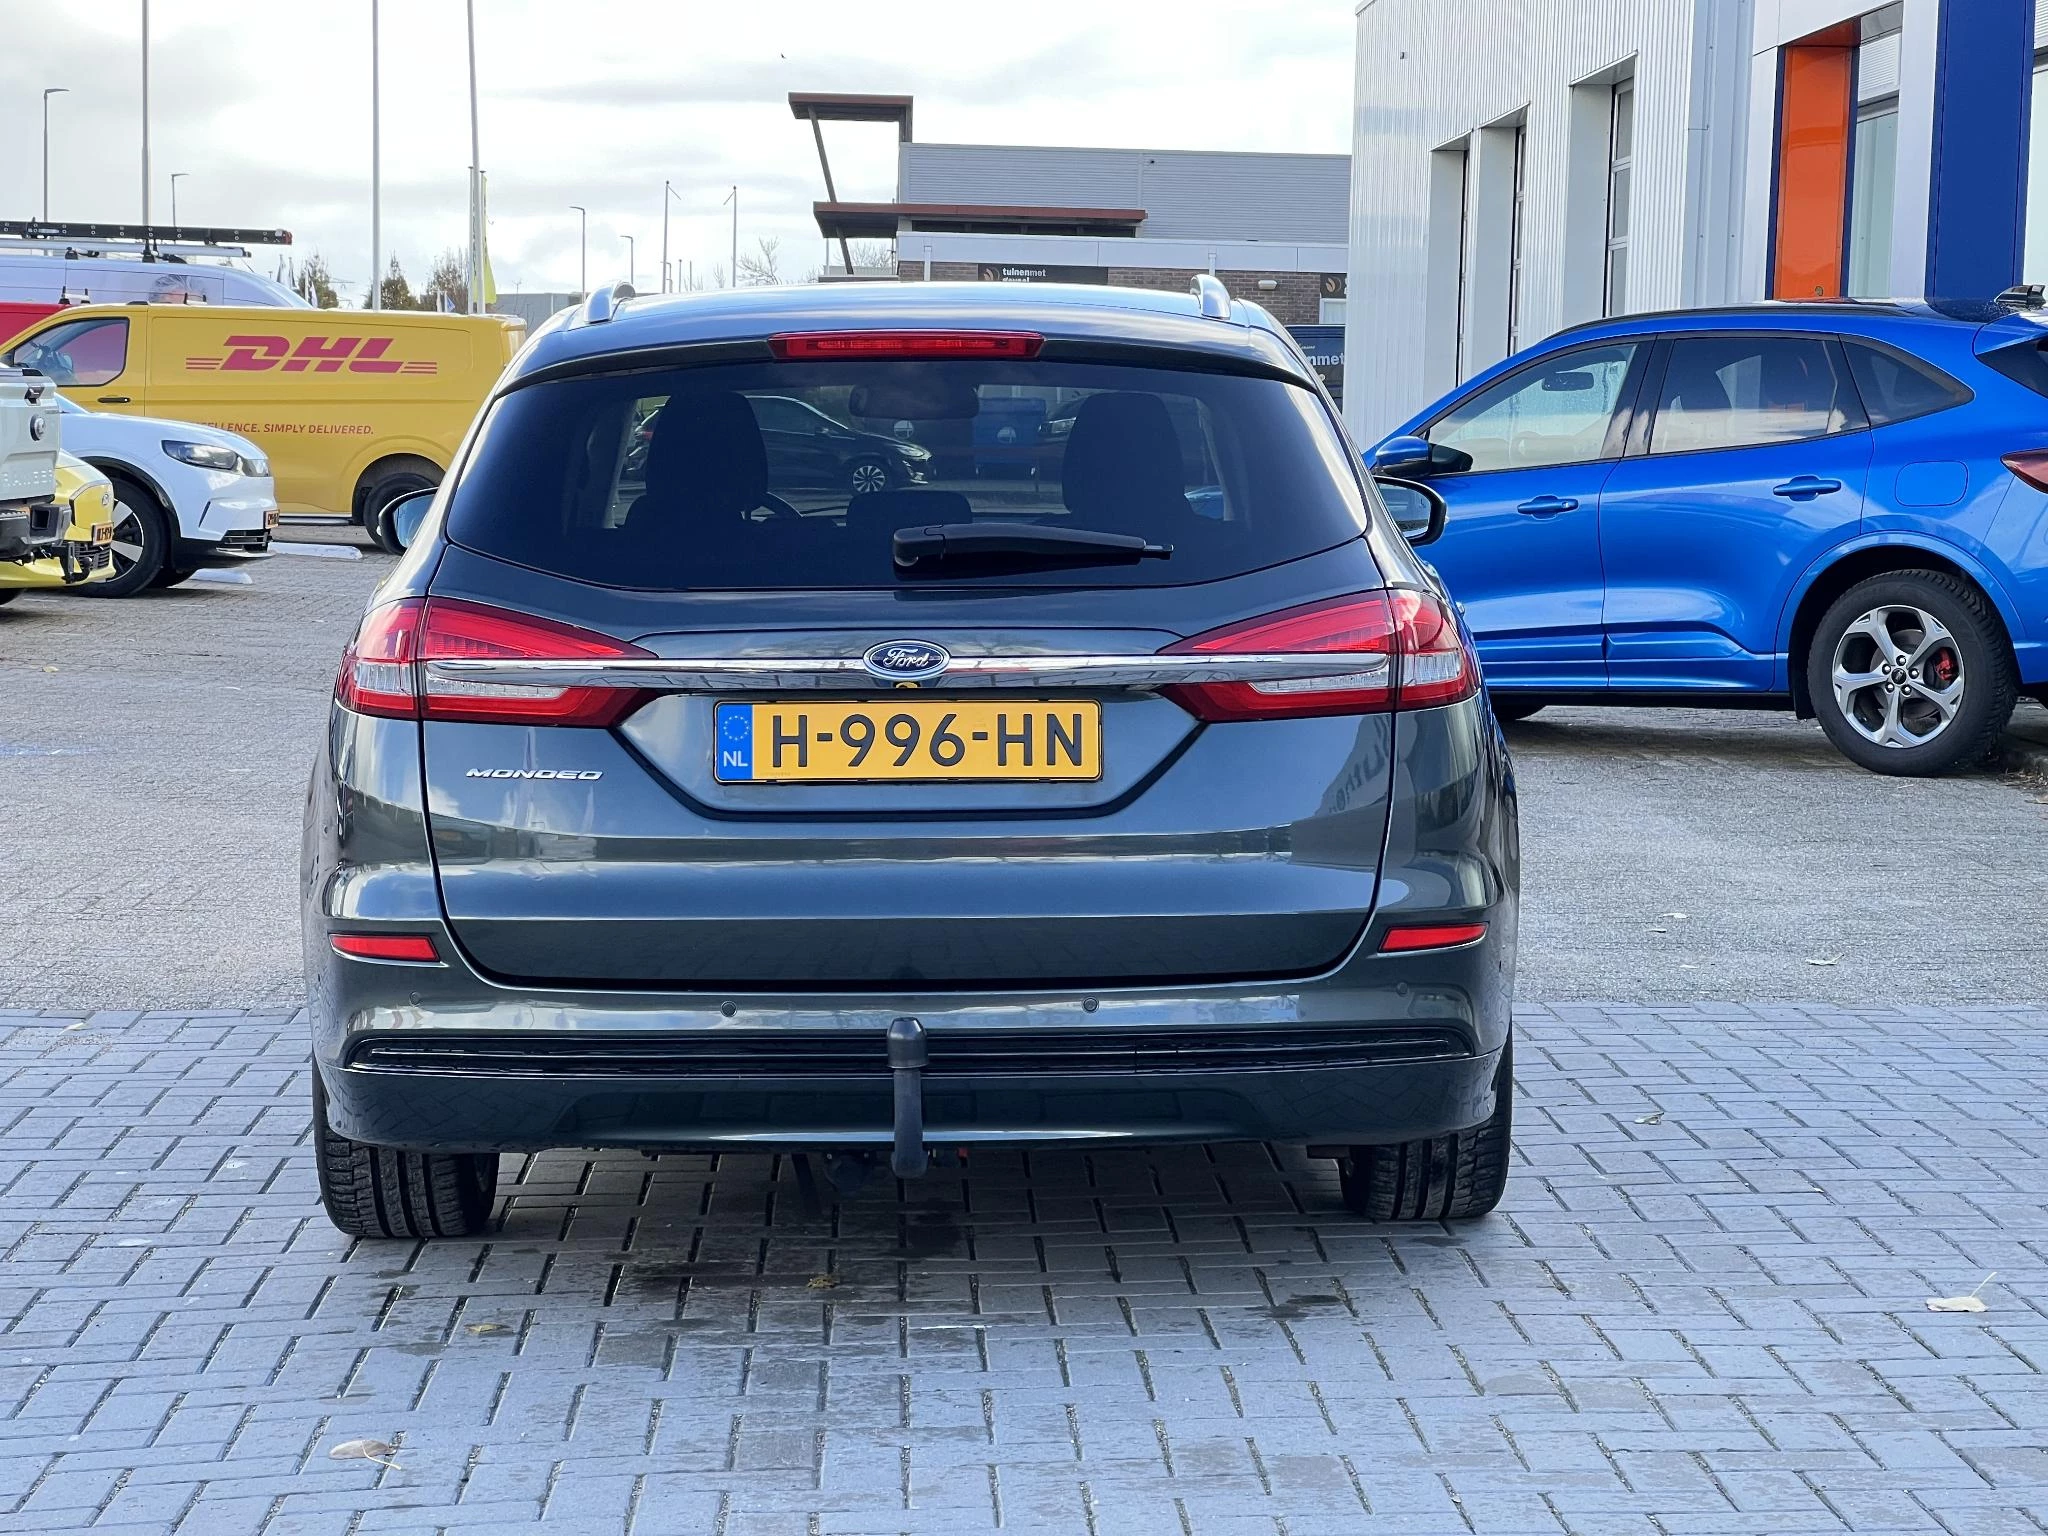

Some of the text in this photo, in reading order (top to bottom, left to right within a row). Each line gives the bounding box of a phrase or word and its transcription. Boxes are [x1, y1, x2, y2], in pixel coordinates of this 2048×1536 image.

[219, 335, 404, 374] DHL
[200, 421, 374, 435] ELLENCE. SIMPLY DELIVERED.
[882, 647, 930, 668] Ford
[723, 713, 1082, 768] NL H-996-HN
[466, 768, 603, 780] MONDEO
